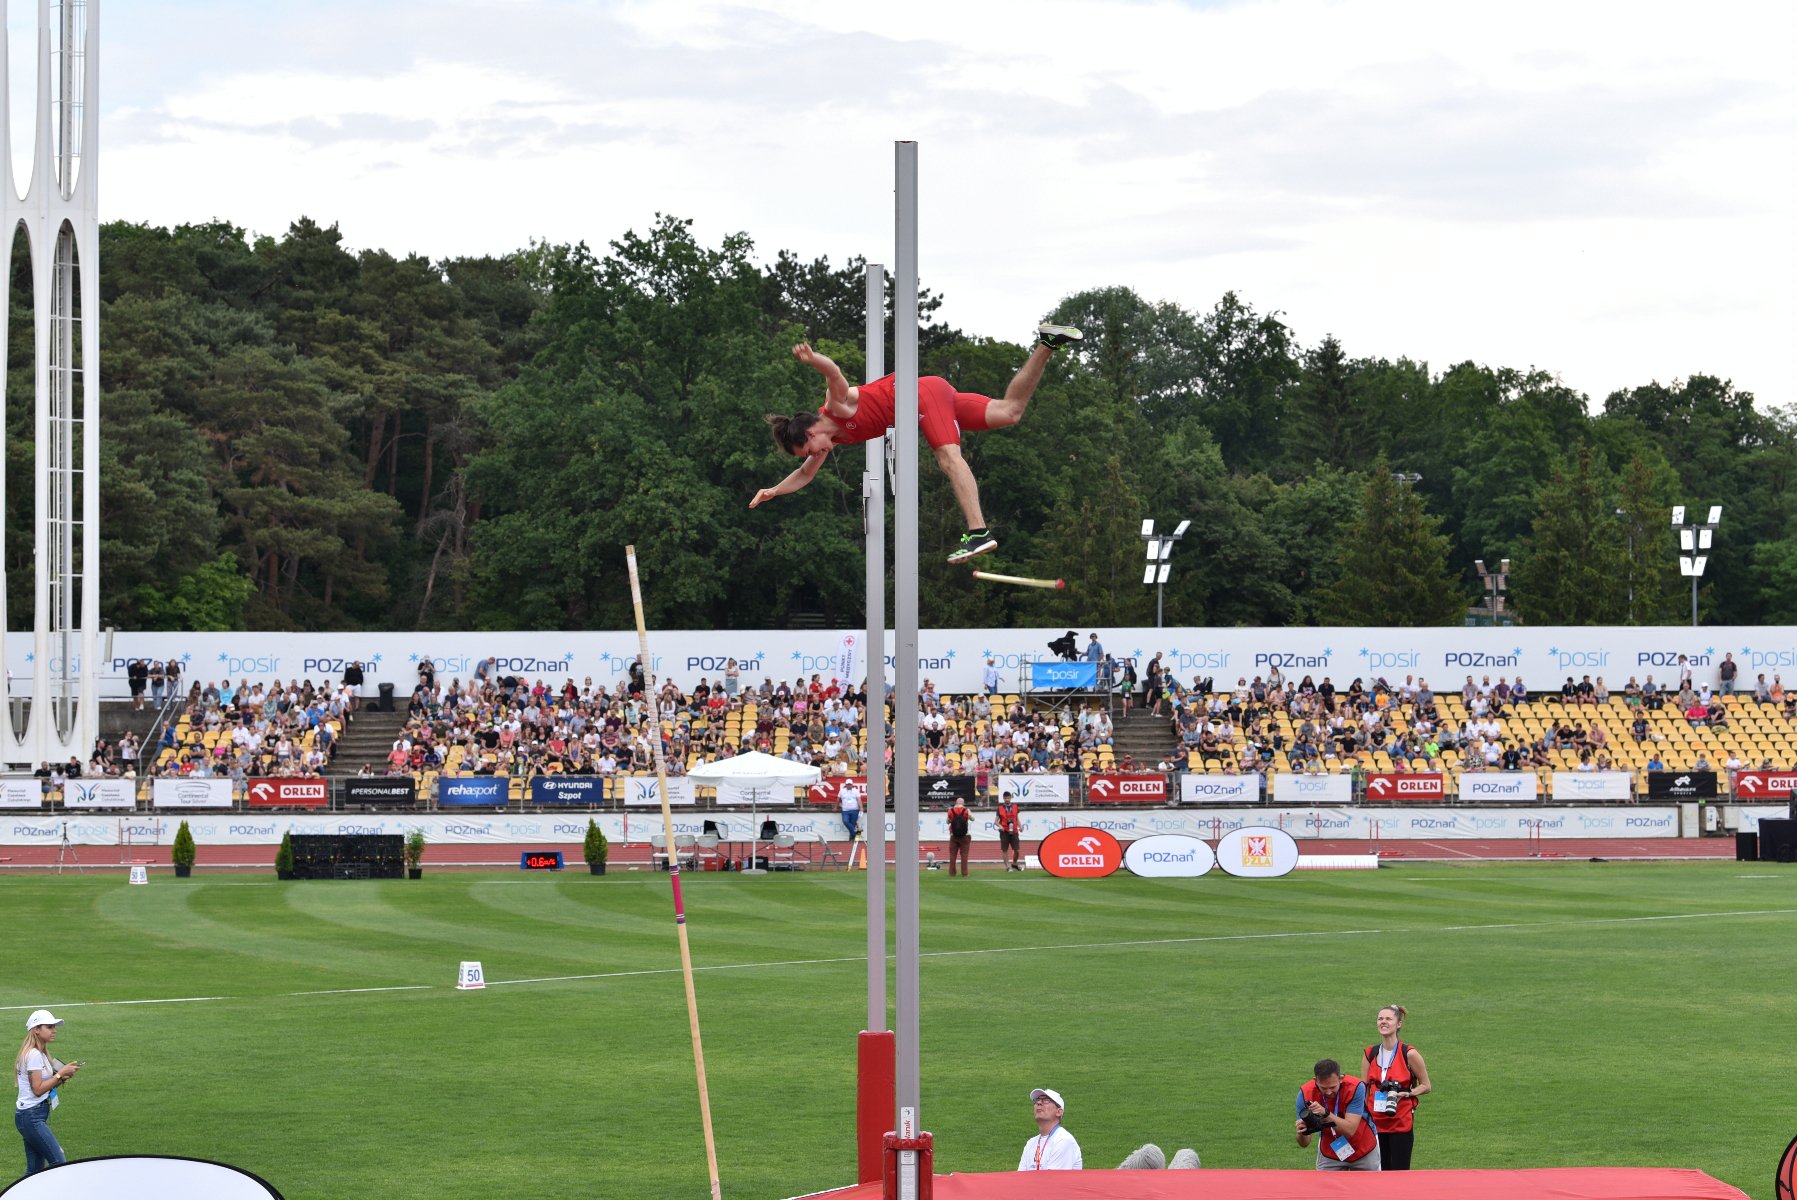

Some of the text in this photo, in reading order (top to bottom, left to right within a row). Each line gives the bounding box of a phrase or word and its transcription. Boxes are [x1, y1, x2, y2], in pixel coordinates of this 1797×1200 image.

[687, 656, 760, 671] POZan
[1179, 649, 1231, 672] posir
[1255, 653, 1327, 667] POZnan
[1369, 648, 1421, 671] posir
[1445, 653, 1517, 667] POZnan
[1559, 648, 1610, 670] posir
[228, 654, 280, 677] posir
[495, 658, 568, 672] POZnan
[1052, 669, 1079, 681] posir
[1123, 783, 1160, 792] ORLEN
[1195, 785, 1242, 794] POZnan
[1299, 781, 1328, 792] posir
[1400, 781, 1438, 790] ORLEN
[1472, 783, 1519, 793] POZnan
[1578, 779, 1606, 790] posir
[283, 787, 321, 796] ORLEN
[351, 787, 409, 795] #PERSONALBEST
[447, 784, 497, 798] rehasport
[558, 791, 582, 801] Szpot
[1091, 821, 1134, 831] POZnan
[1306, 818, 1350, 828] POZnan
[1411, 818, 1455, 829] POZnan
[1626, 817, 1670, 828] POZnan
[13, 826, 58, 837] POZnan
[229, 825, 274, 835] POZnan
[445, 825, 490, 836] POZnan
[1062, 857, 1100, 865] ORLEN
[1143, 852, 1194, 863] POZnan
[467, 969, 480, 982] 50
